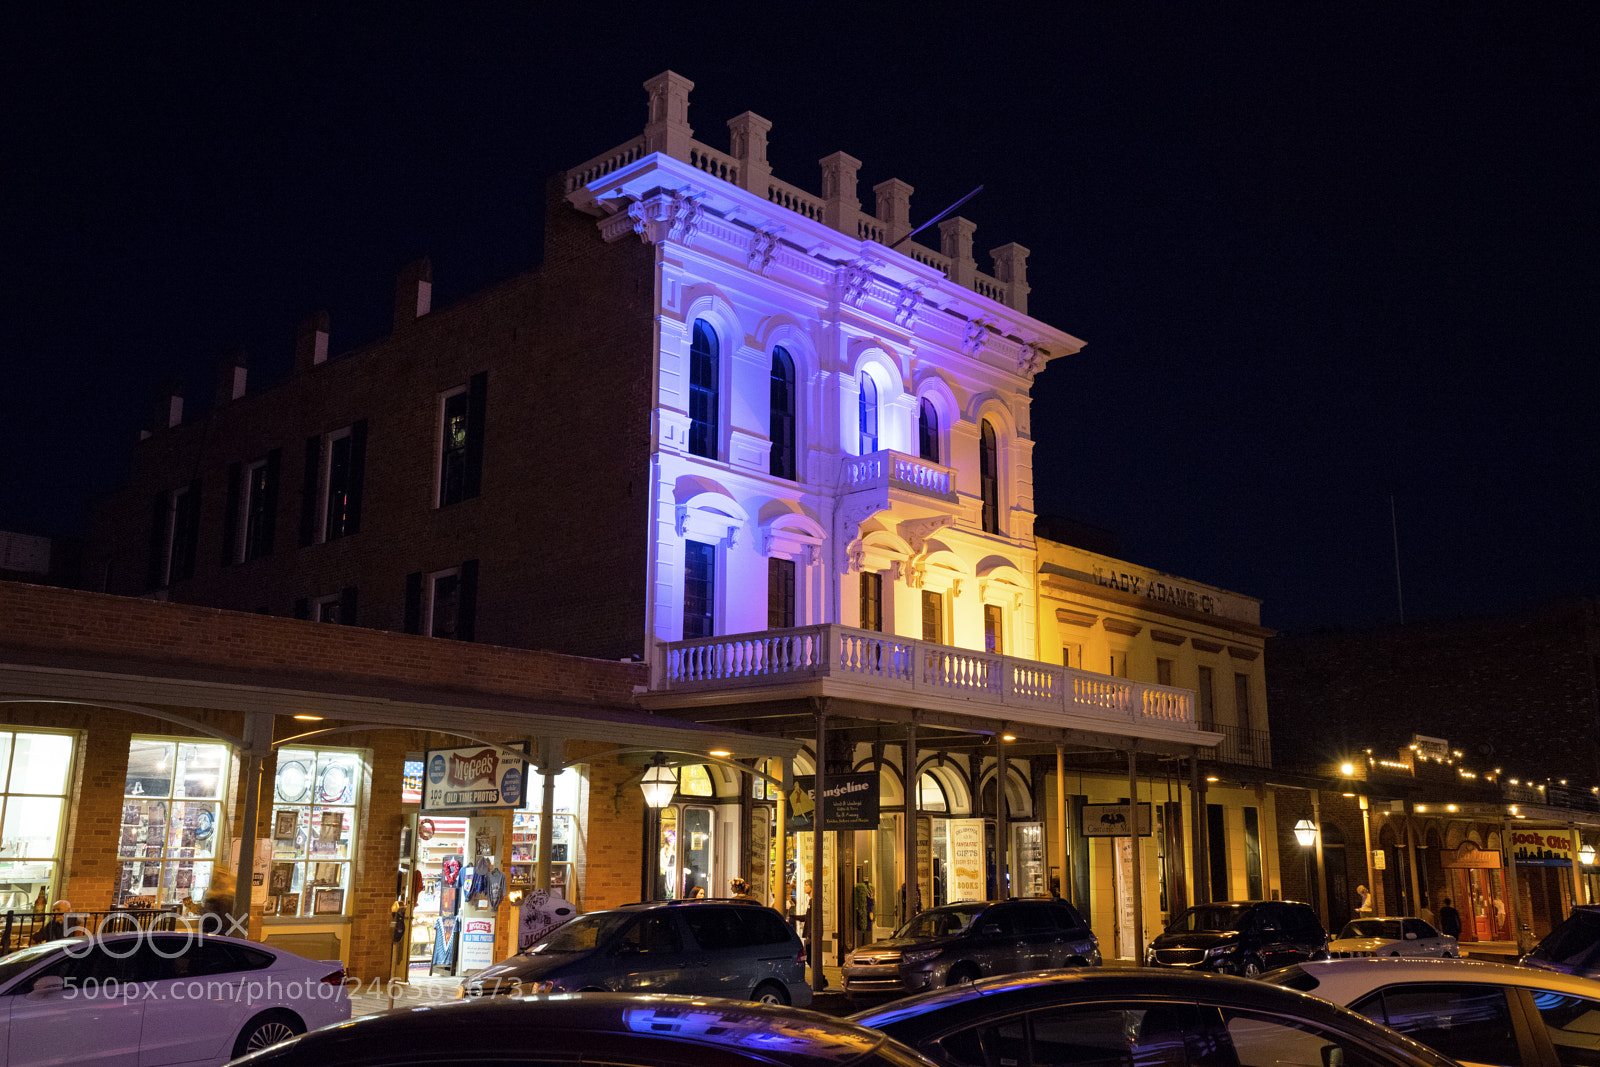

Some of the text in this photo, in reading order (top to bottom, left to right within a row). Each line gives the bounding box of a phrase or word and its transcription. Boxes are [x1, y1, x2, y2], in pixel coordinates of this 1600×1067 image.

[1096, 566, 1140, 595] LADY
[446, 790, 498, 803] OLD TIME PHOTOS
[957, 881, 978, 889] BOOKS
